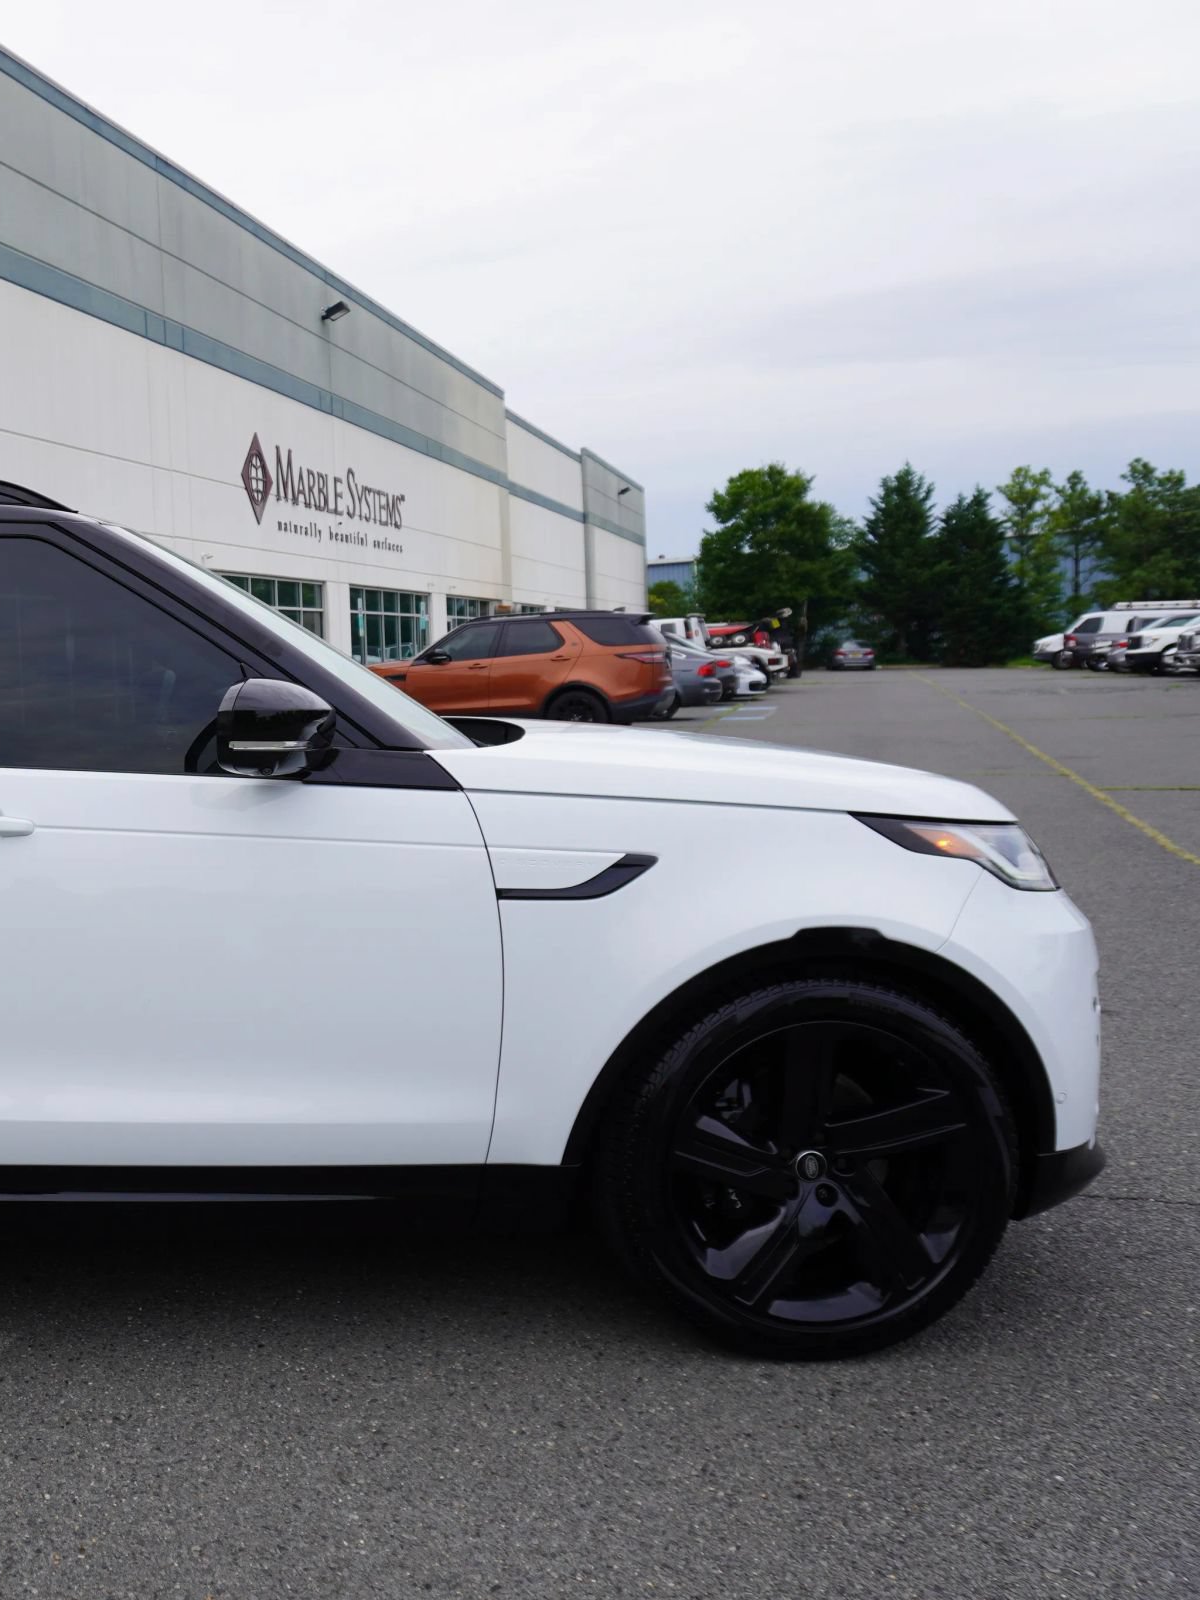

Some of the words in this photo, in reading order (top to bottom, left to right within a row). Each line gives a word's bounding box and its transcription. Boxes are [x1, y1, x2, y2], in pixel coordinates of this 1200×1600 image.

[275, 445, 344, 516] MARBLE
[277, 520, 321, 543] naturally
[329, 526, 368, 547] beautiful
[373, 538, 403, 553] surfaces
